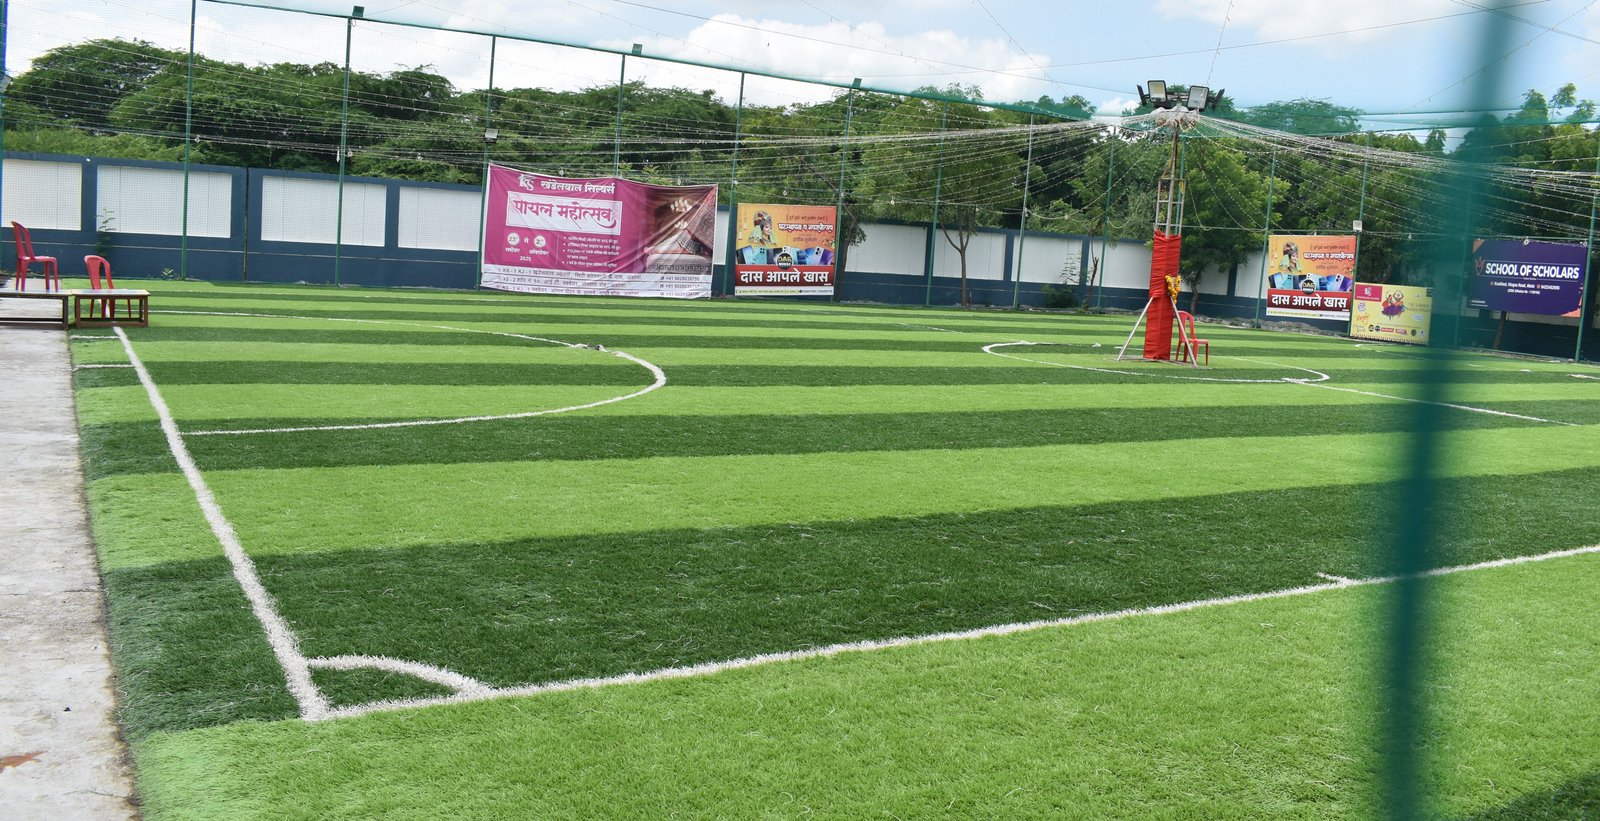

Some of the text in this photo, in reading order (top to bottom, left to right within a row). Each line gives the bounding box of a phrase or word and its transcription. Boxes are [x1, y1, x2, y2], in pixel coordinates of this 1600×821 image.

[513, 199, 617, 229] पायल महोत्सव
[740, 268, 829, 284] दास आपले खास
[1485, 263, 1580, 279] SCHOOL OF SCHOLARS
[1271, 294, 1290, 306] दास
[1292, 294, 1322, 307] आपले
[1324, 297, 1348, 308] खास
